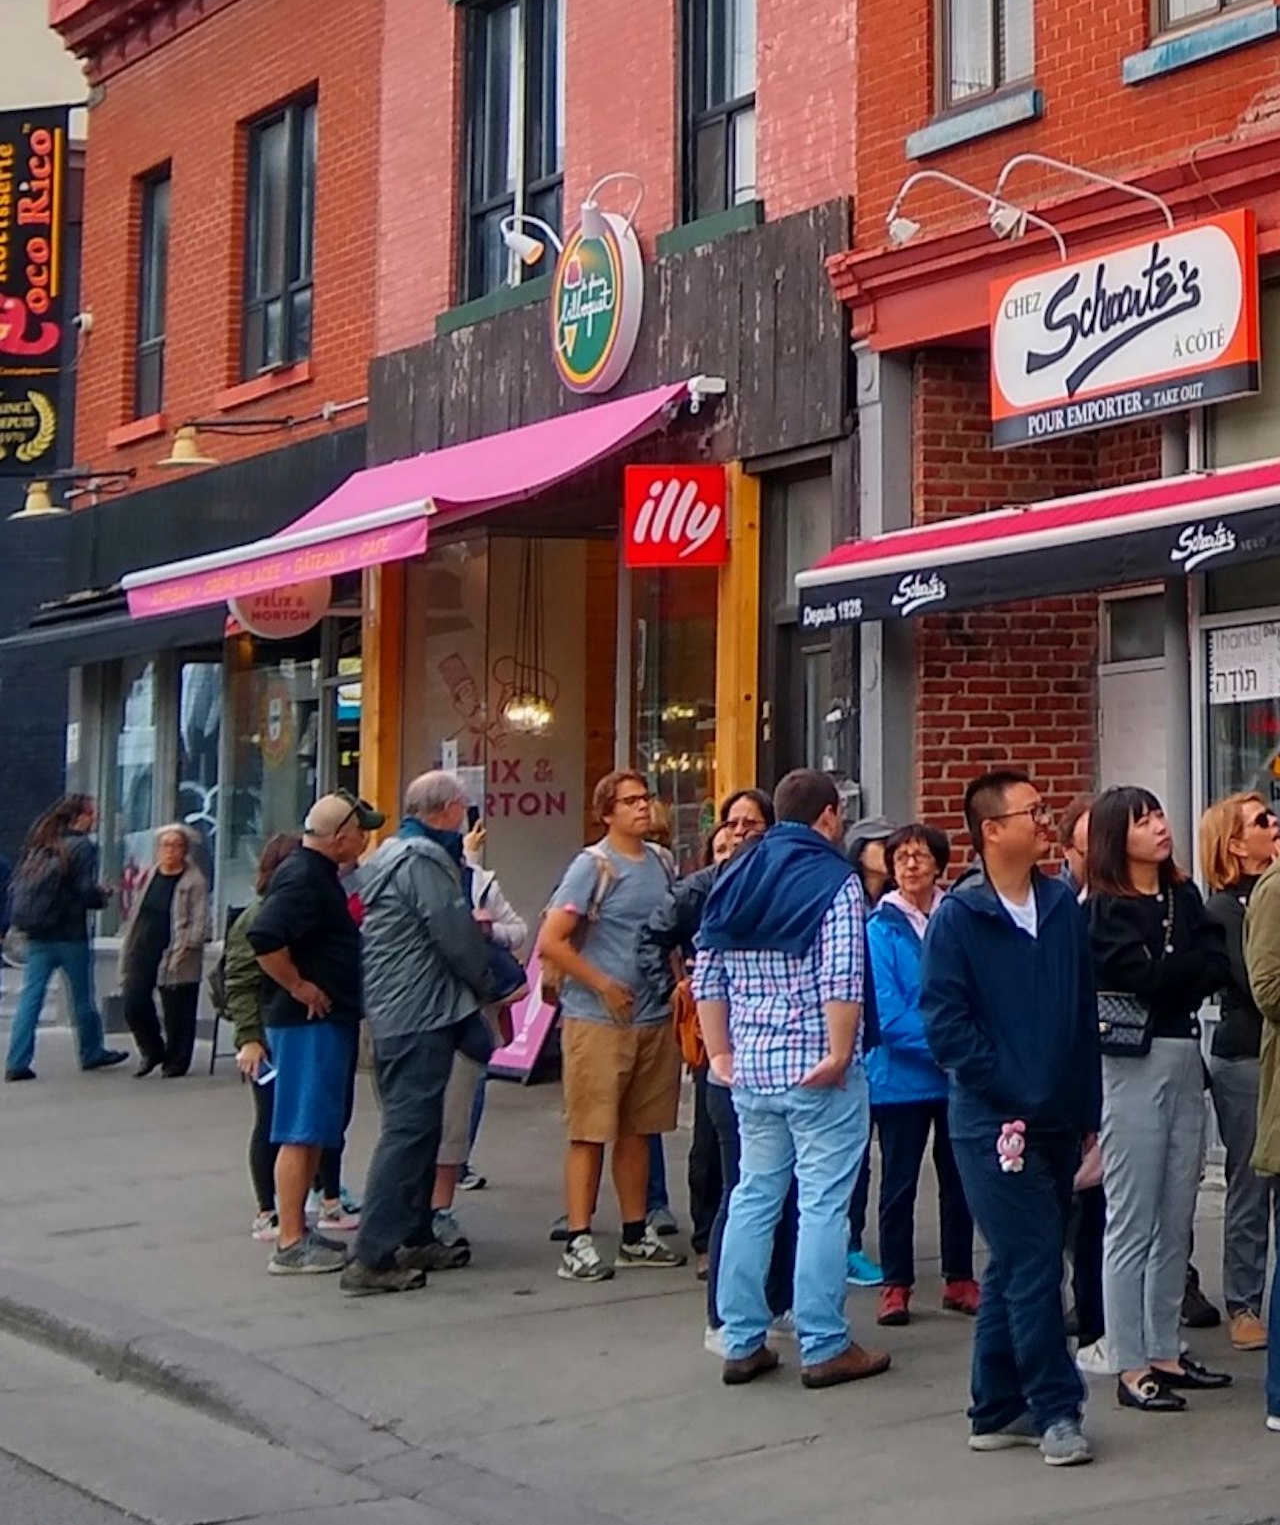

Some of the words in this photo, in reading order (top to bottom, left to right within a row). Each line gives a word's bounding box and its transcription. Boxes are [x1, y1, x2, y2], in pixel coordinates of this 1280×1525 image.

[17, 128, 52, 226] Rico
[1004, 292, 1041, 320] CHEZ
[1026, 242, 1200, 395] Schwartz's
[1185, 325, 1225, 355] CÔTÉ
[1028, 410, 1065, 436] POUR
[1067, 391, 1143, 427] EMPORTER
[1153, 390, 1179, 407] TAKE
[1180, 382, 1204, 401] OUT
[632, 479, 721, 558] illy
[294, 549, 345, 575] GÂTEAUX
[359, 535, 390, 558] CAFÉ
[251, 610, 310, 621] NORTON
[803, 602, 836, 629] Depuis
[838, 598, 862, 621] 1928
[487, 791, 566, 817] RTON
